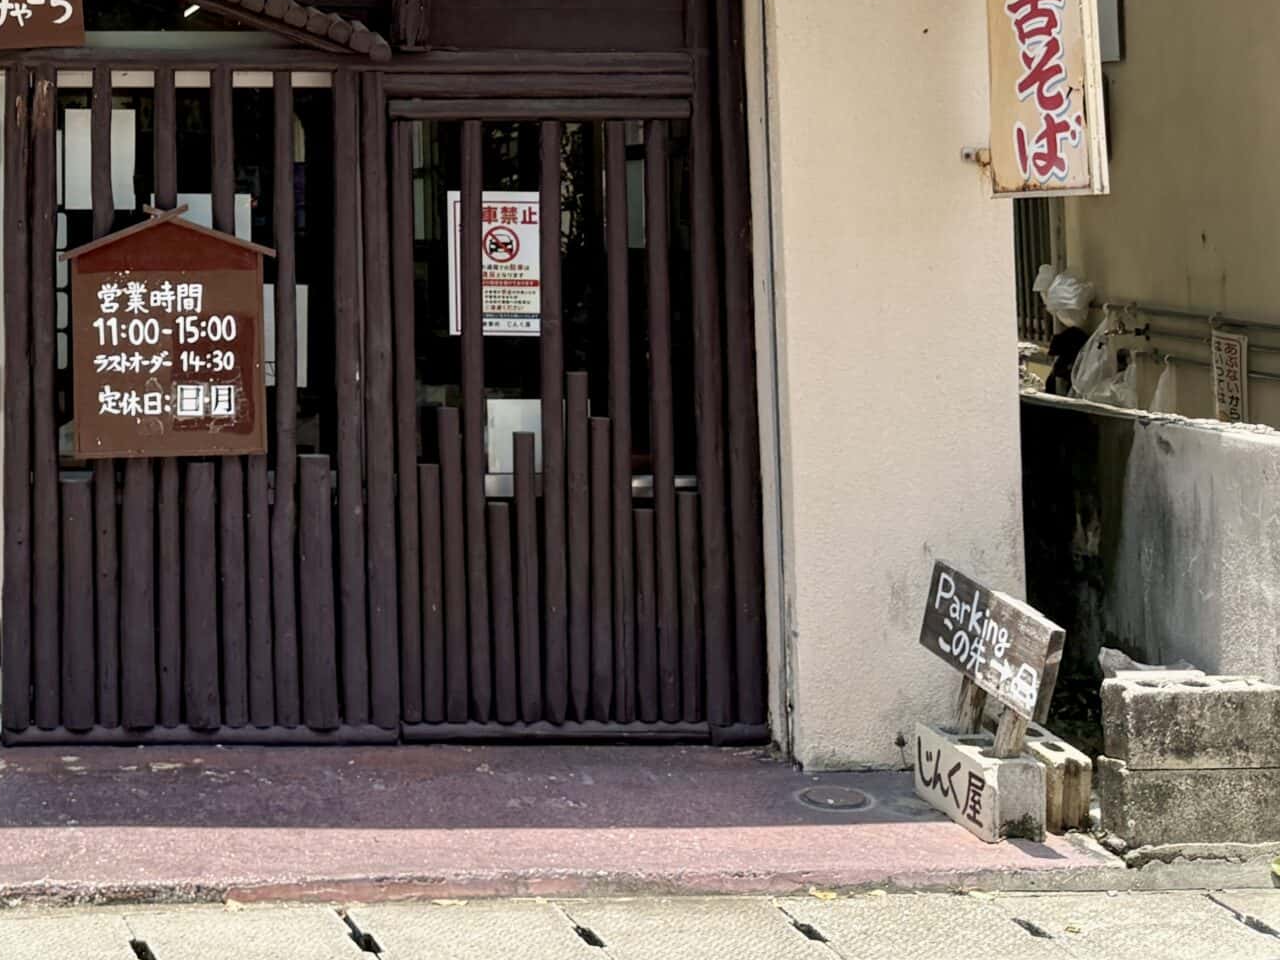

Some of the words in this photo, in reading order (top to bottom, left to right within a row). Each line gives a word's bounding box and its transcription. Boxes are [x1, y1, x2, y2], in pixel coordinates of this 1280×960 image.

[481, 206, 538, 225] 車禁止
[96, 280, 204, 314] 営業時間
[93, 350, 174, 374] ラストオーダー
[179, 349, 236, 373] 14:30
[934, 571, 1014, 658] Parking
[938, 617, 988, 680] この先
[917, 735, 987, 829] じんく屋
